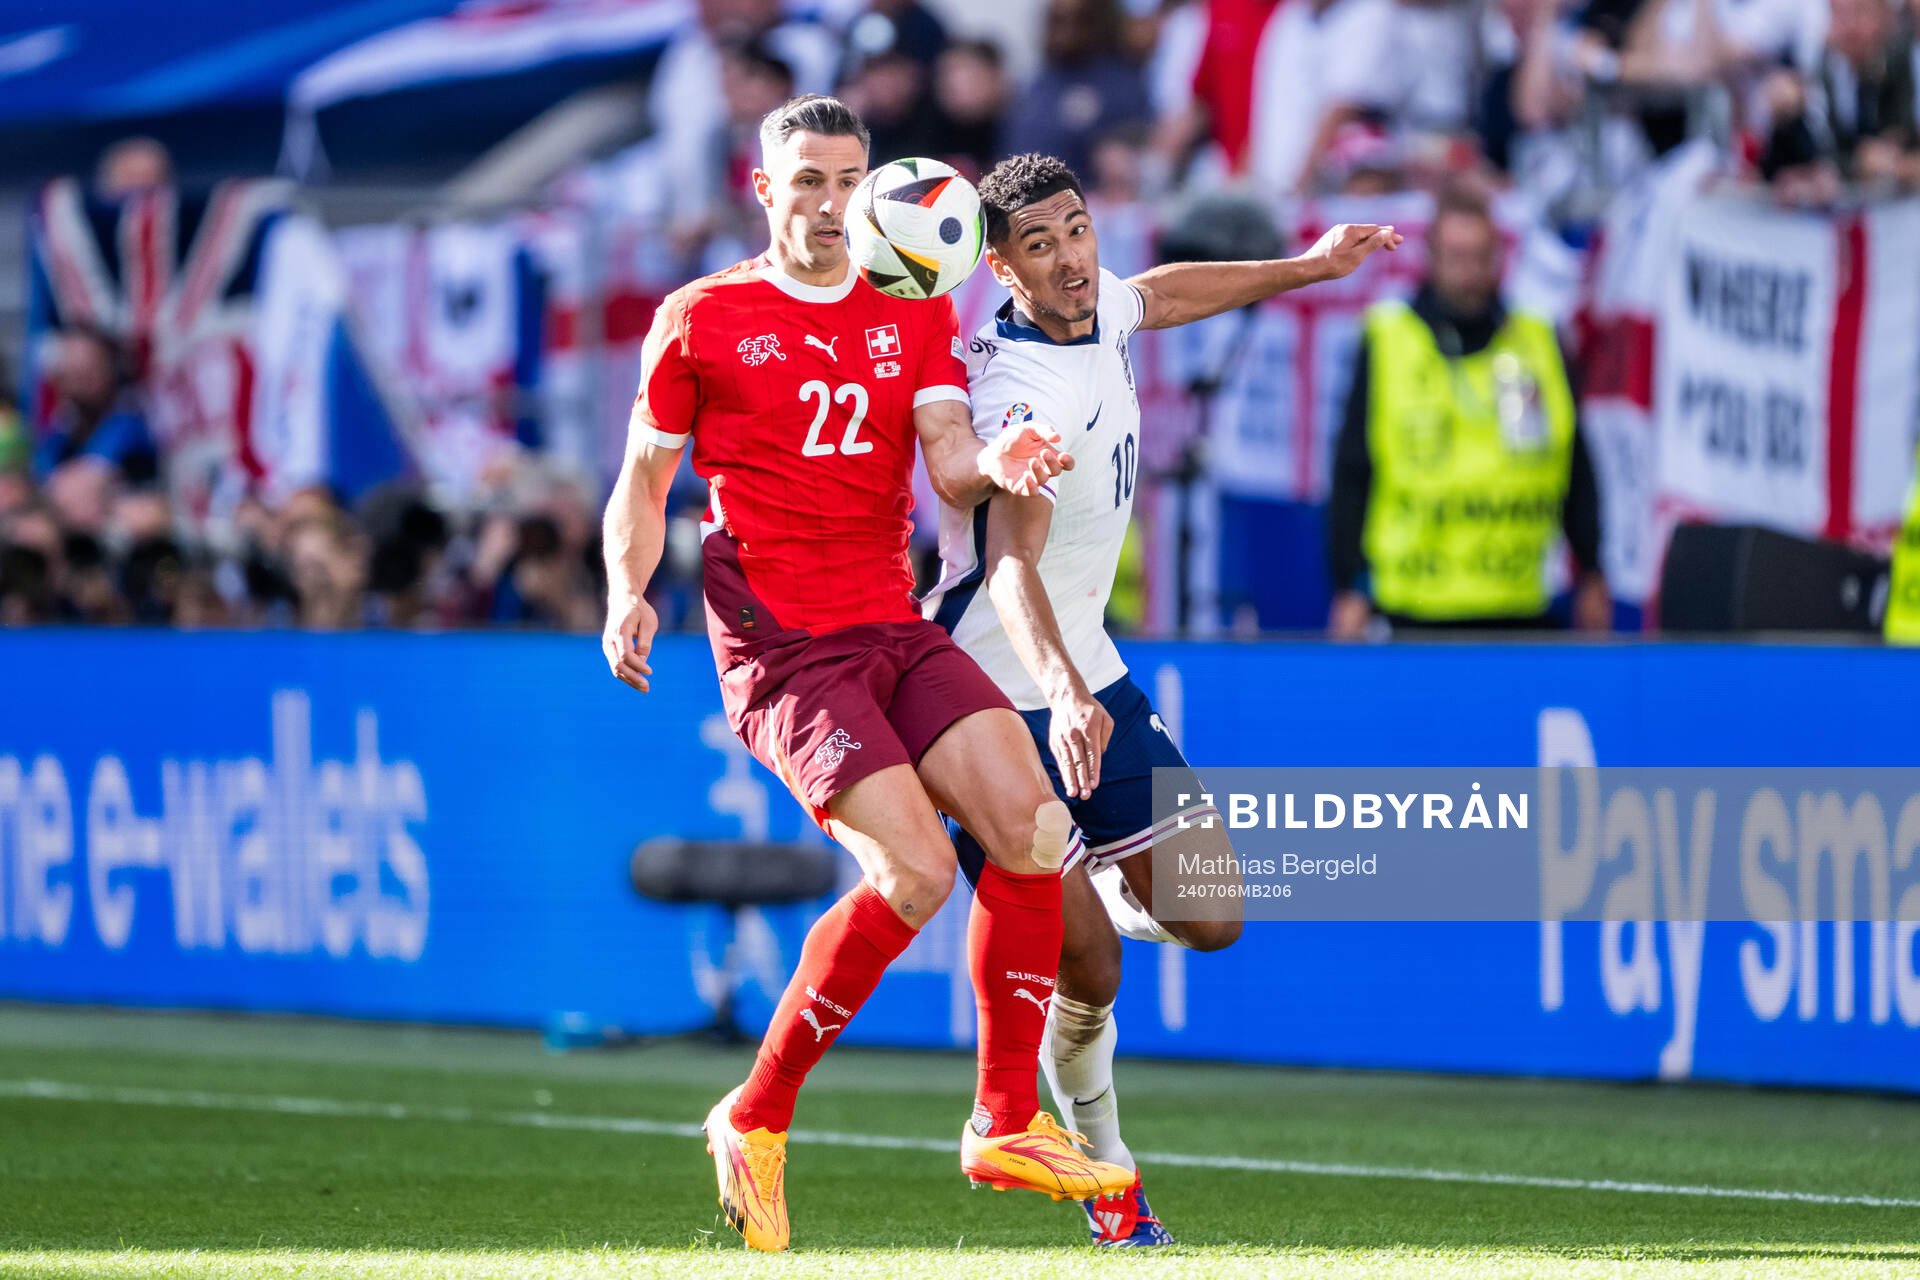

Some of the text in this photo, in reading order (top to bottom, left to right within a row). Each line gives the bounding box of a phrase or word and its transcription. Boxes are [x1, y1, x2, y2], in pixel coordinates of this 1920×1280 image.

[798, 379, 874, 457] 22
[1112, 432, 1135, 510] 10
[1536, 706, 1715, 1080] Pay
[805, 985, 852, 1019] SUISSE
[1005, 971, 1055, 987] SUISSE
